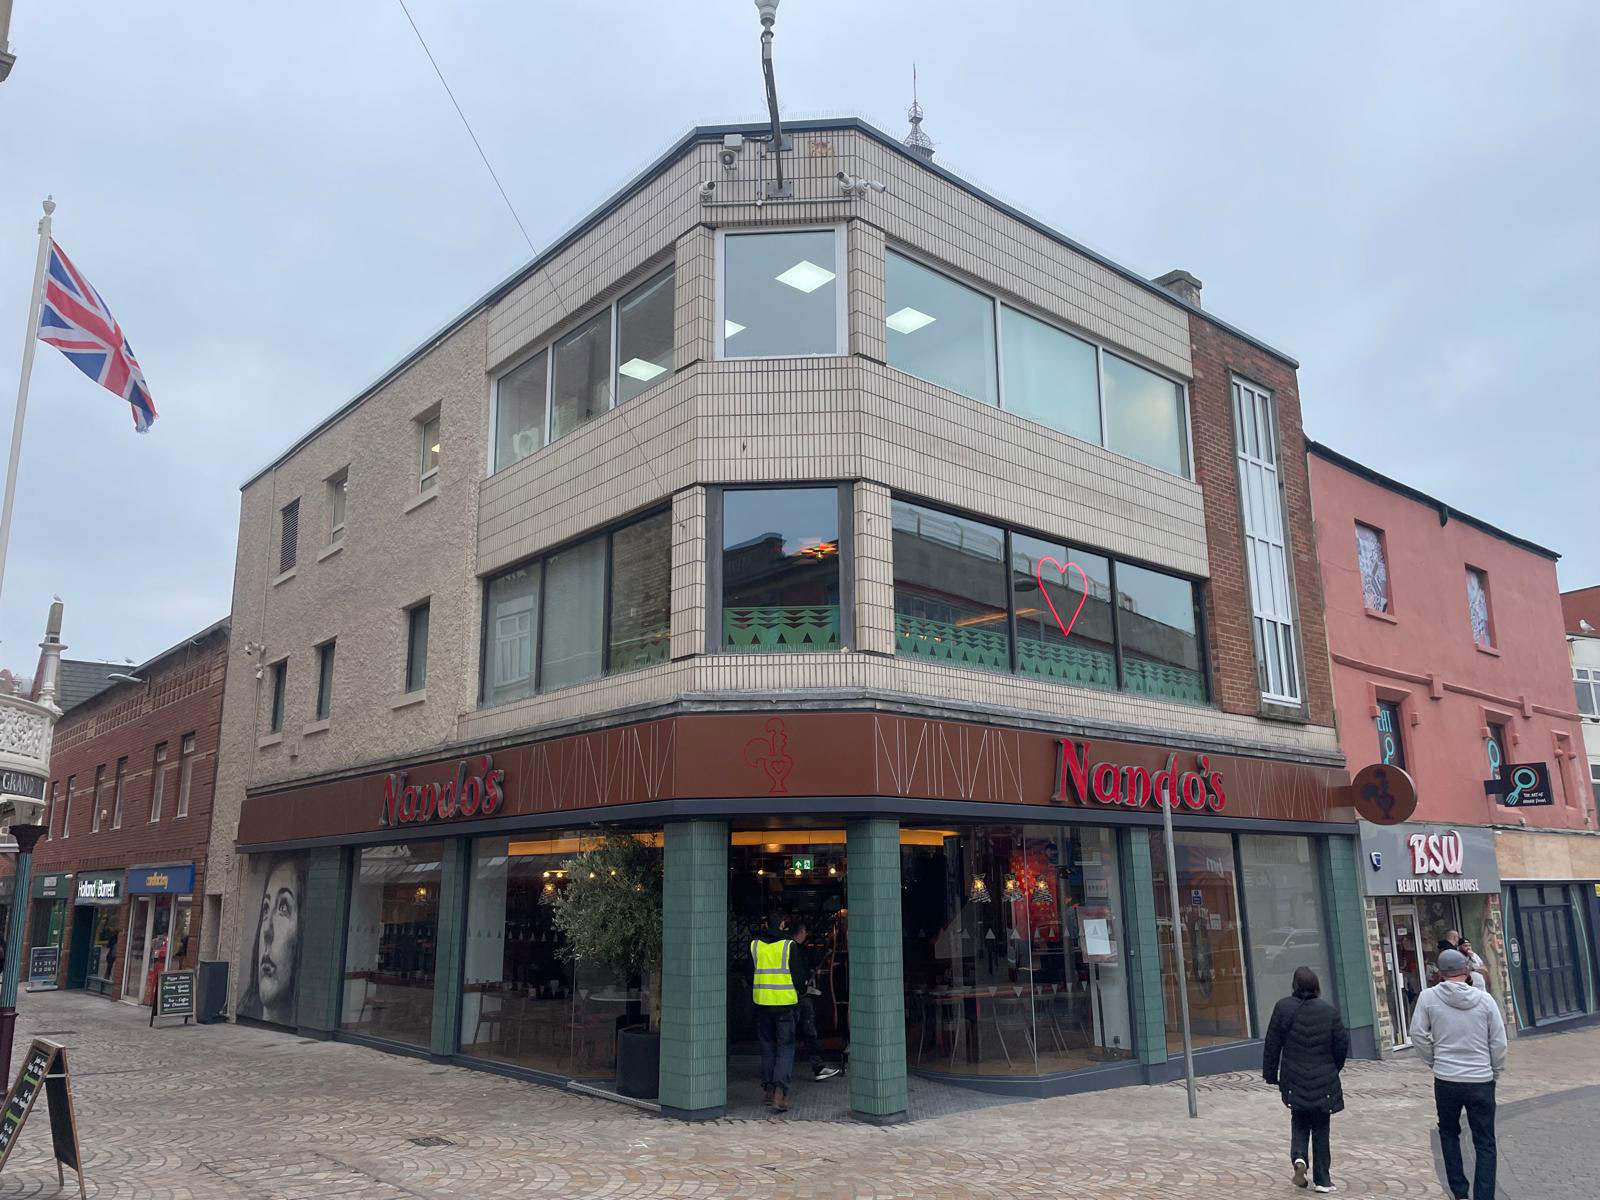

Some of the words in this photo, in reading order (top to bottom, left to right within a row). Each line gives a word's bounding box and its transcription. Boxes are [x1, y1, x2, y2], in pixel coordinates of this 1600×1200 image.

[378, 752, 505, 827] Nando's
[1052, 738, 1226, 812] Nando's
[1409, 830, 1464, 875] BSW
[1397, 879, 1423, 893] BEAUTY
[1424, 879, 1440, 892] SPOT
[1441, 879, 1479, 892] WAREHOUSE
